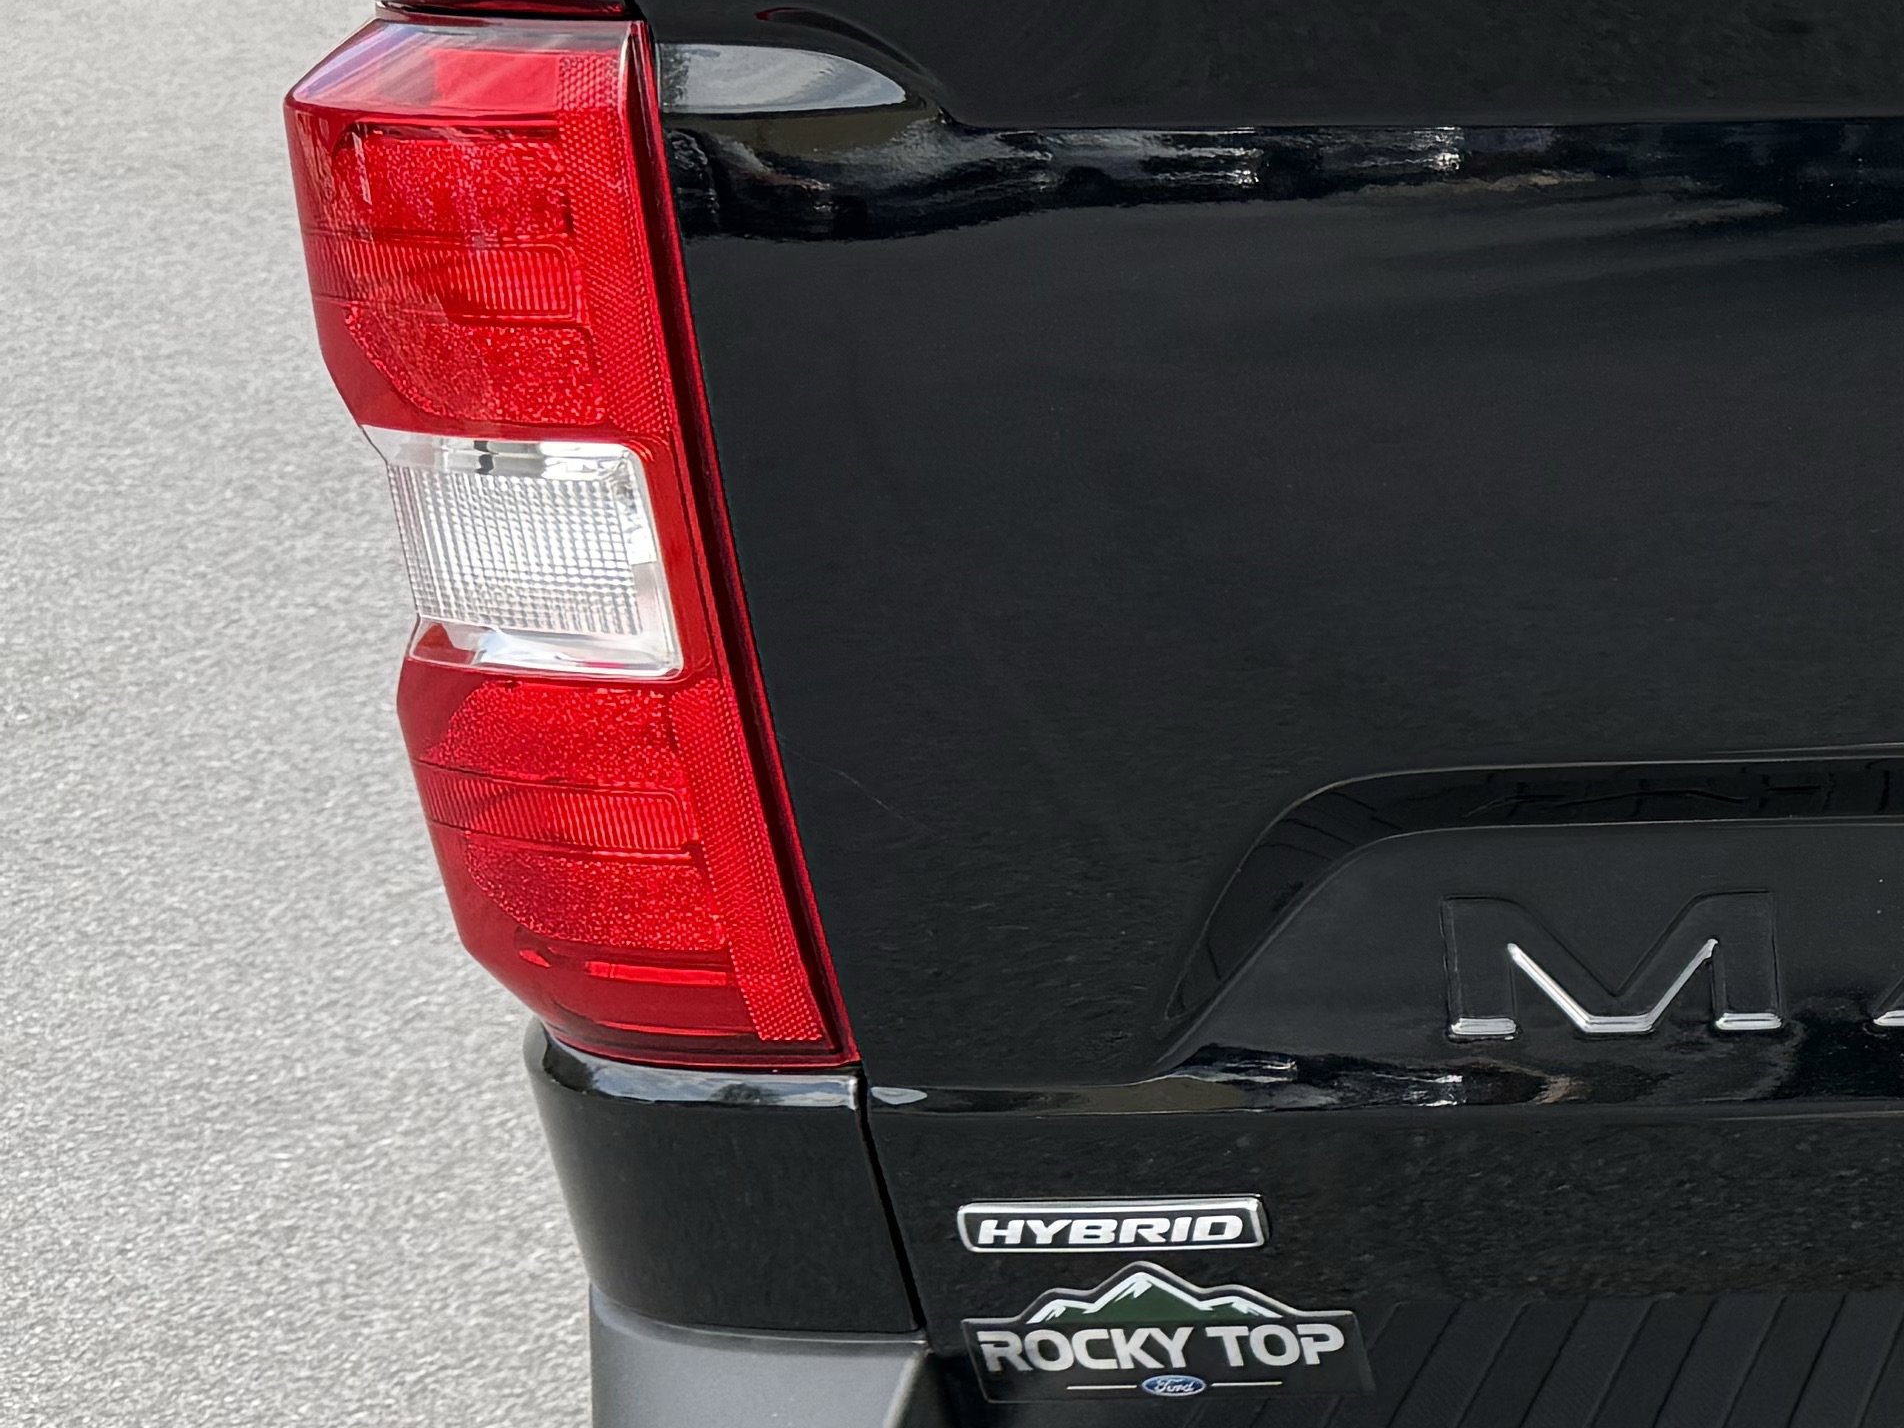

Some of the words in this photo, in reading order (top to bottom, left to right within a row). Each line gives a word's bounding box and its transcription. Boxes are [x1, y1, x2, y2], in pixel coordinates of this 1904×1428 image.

[977, 1214, 1245, 1245] HYBRID
[976, 1325, 1196, 1372] ROCKY
[1205, 1323, 1345, 1368] TOP
